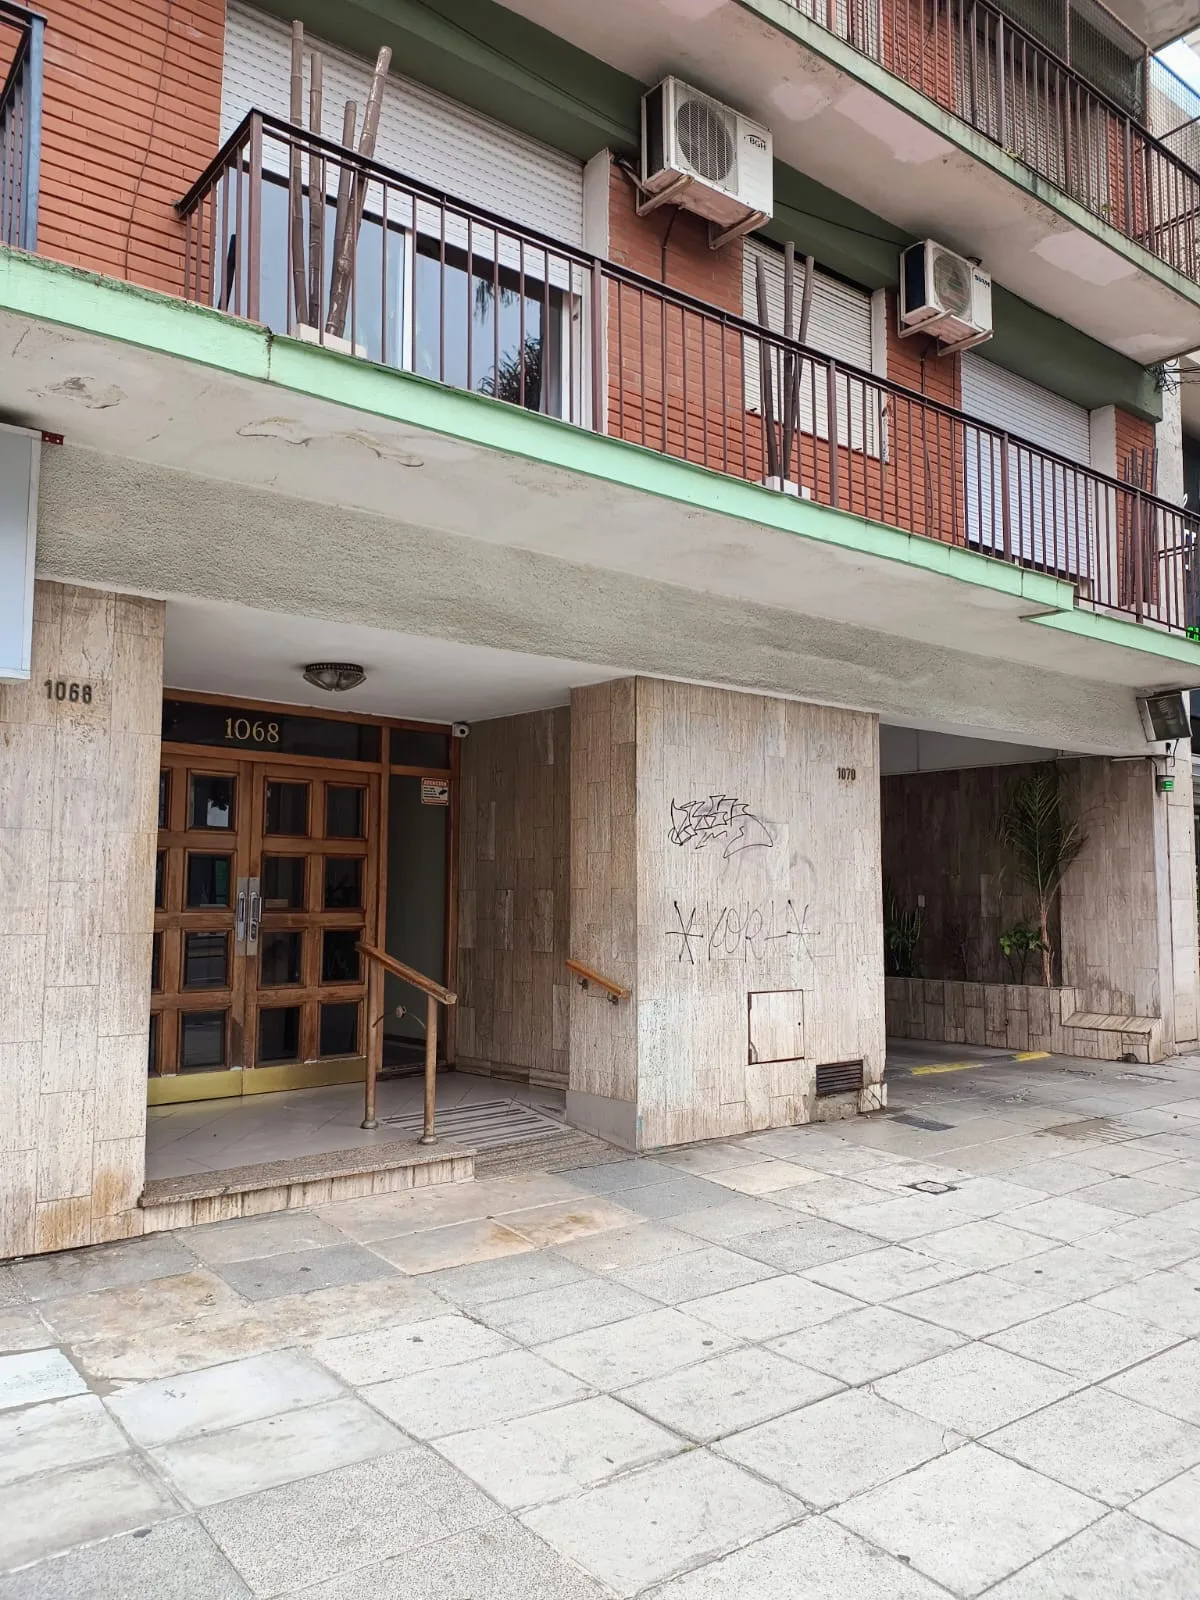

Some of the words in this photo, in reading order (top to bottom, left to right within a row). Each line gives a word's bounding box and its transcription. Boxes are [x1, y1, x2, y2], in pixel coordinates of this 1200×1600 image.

[749, 136, 766, 151] BGH
[43, 679, 92, 704] 1068
[224, 717, 279, 743] 1068
[836, 767, 856, 781] 1070
